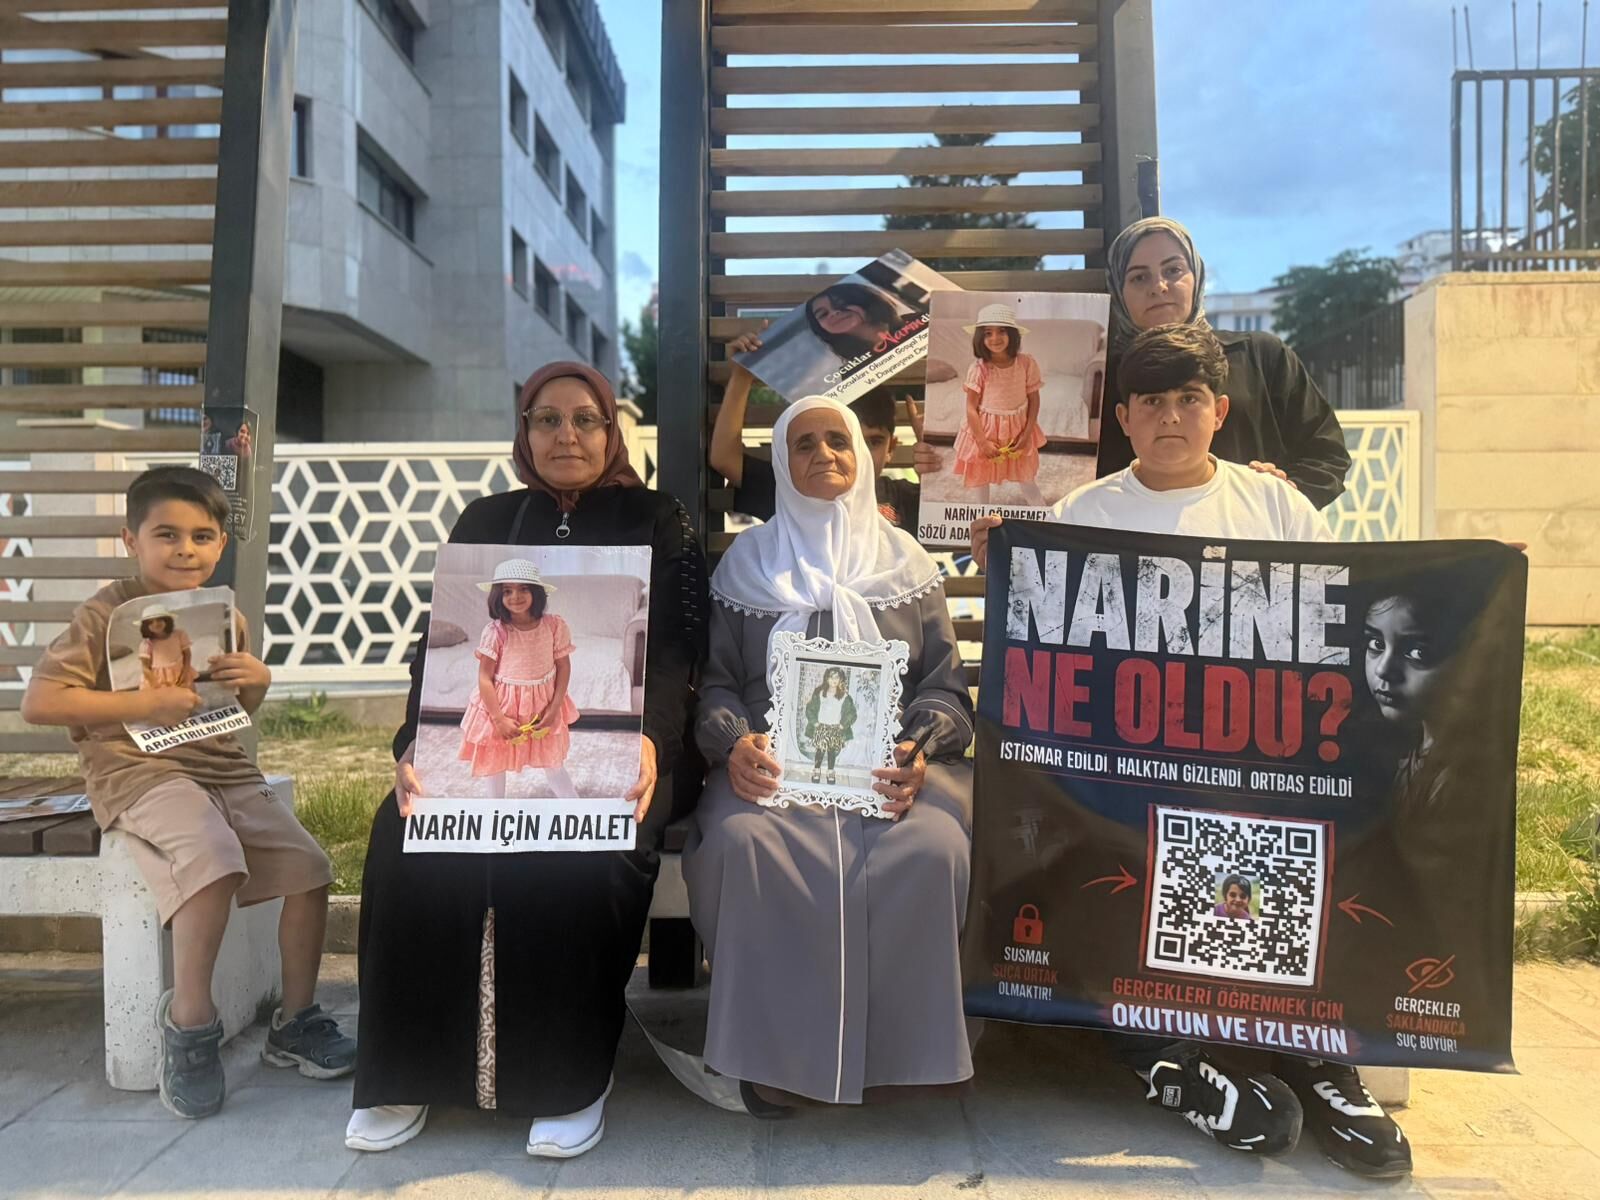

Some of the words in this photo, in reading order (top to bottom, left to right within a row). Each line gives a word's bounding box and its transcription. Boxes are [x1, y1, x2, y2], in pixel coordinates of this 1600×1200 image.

[823, 351, 872, 384] Çocuklar
[868, 353, 895, 371] Okusun
[863, 377, 876, 385] Ve
[919, 524, 946, 540] SÖZÜ
[1006, 546, 1350, 666] NARİNE
[200, 706, 239, 724] NEDEN
[1003, 646, 1094, 737] NE
[1114, 657, 1353, 762] OLDU?
[1000, 739, 1063, 767] İSTİSMAR
[1117, 756, 1178, 781] HALKTAN
[1250, 771, 1304, 794] ORTBAS
[1309, 775, 1352, 798] EDİLDİ
[408, 810, 482, 840] NARİN
[491, 810, 541, 846] İÇİN
[548, 814, 634, 840] ADALET
[1003, 946, 1050, 966] SUSMAK
[998, 981, 1052, 1001] OLMAKTIR!
[1112, 977, 1211, 1005] GERÇEKLERİ
[1217, 985, 1305, 1016] ÖĞRENMEK
[1311, 999, 1344, 1020] İÇİN
[1394, 996, 1461, 1018] GERÇEKLER
[1112, 1002, 1209, 1037] OKUTUN
[1216, 1015, 1249, 1042] VE
[1255, 1017, 1348, 1055] İZLEYİN
[1396, 1032, 1417, 1051] SUÇ
[1419, 1033, 1458, 1053] BÜYÜR!
